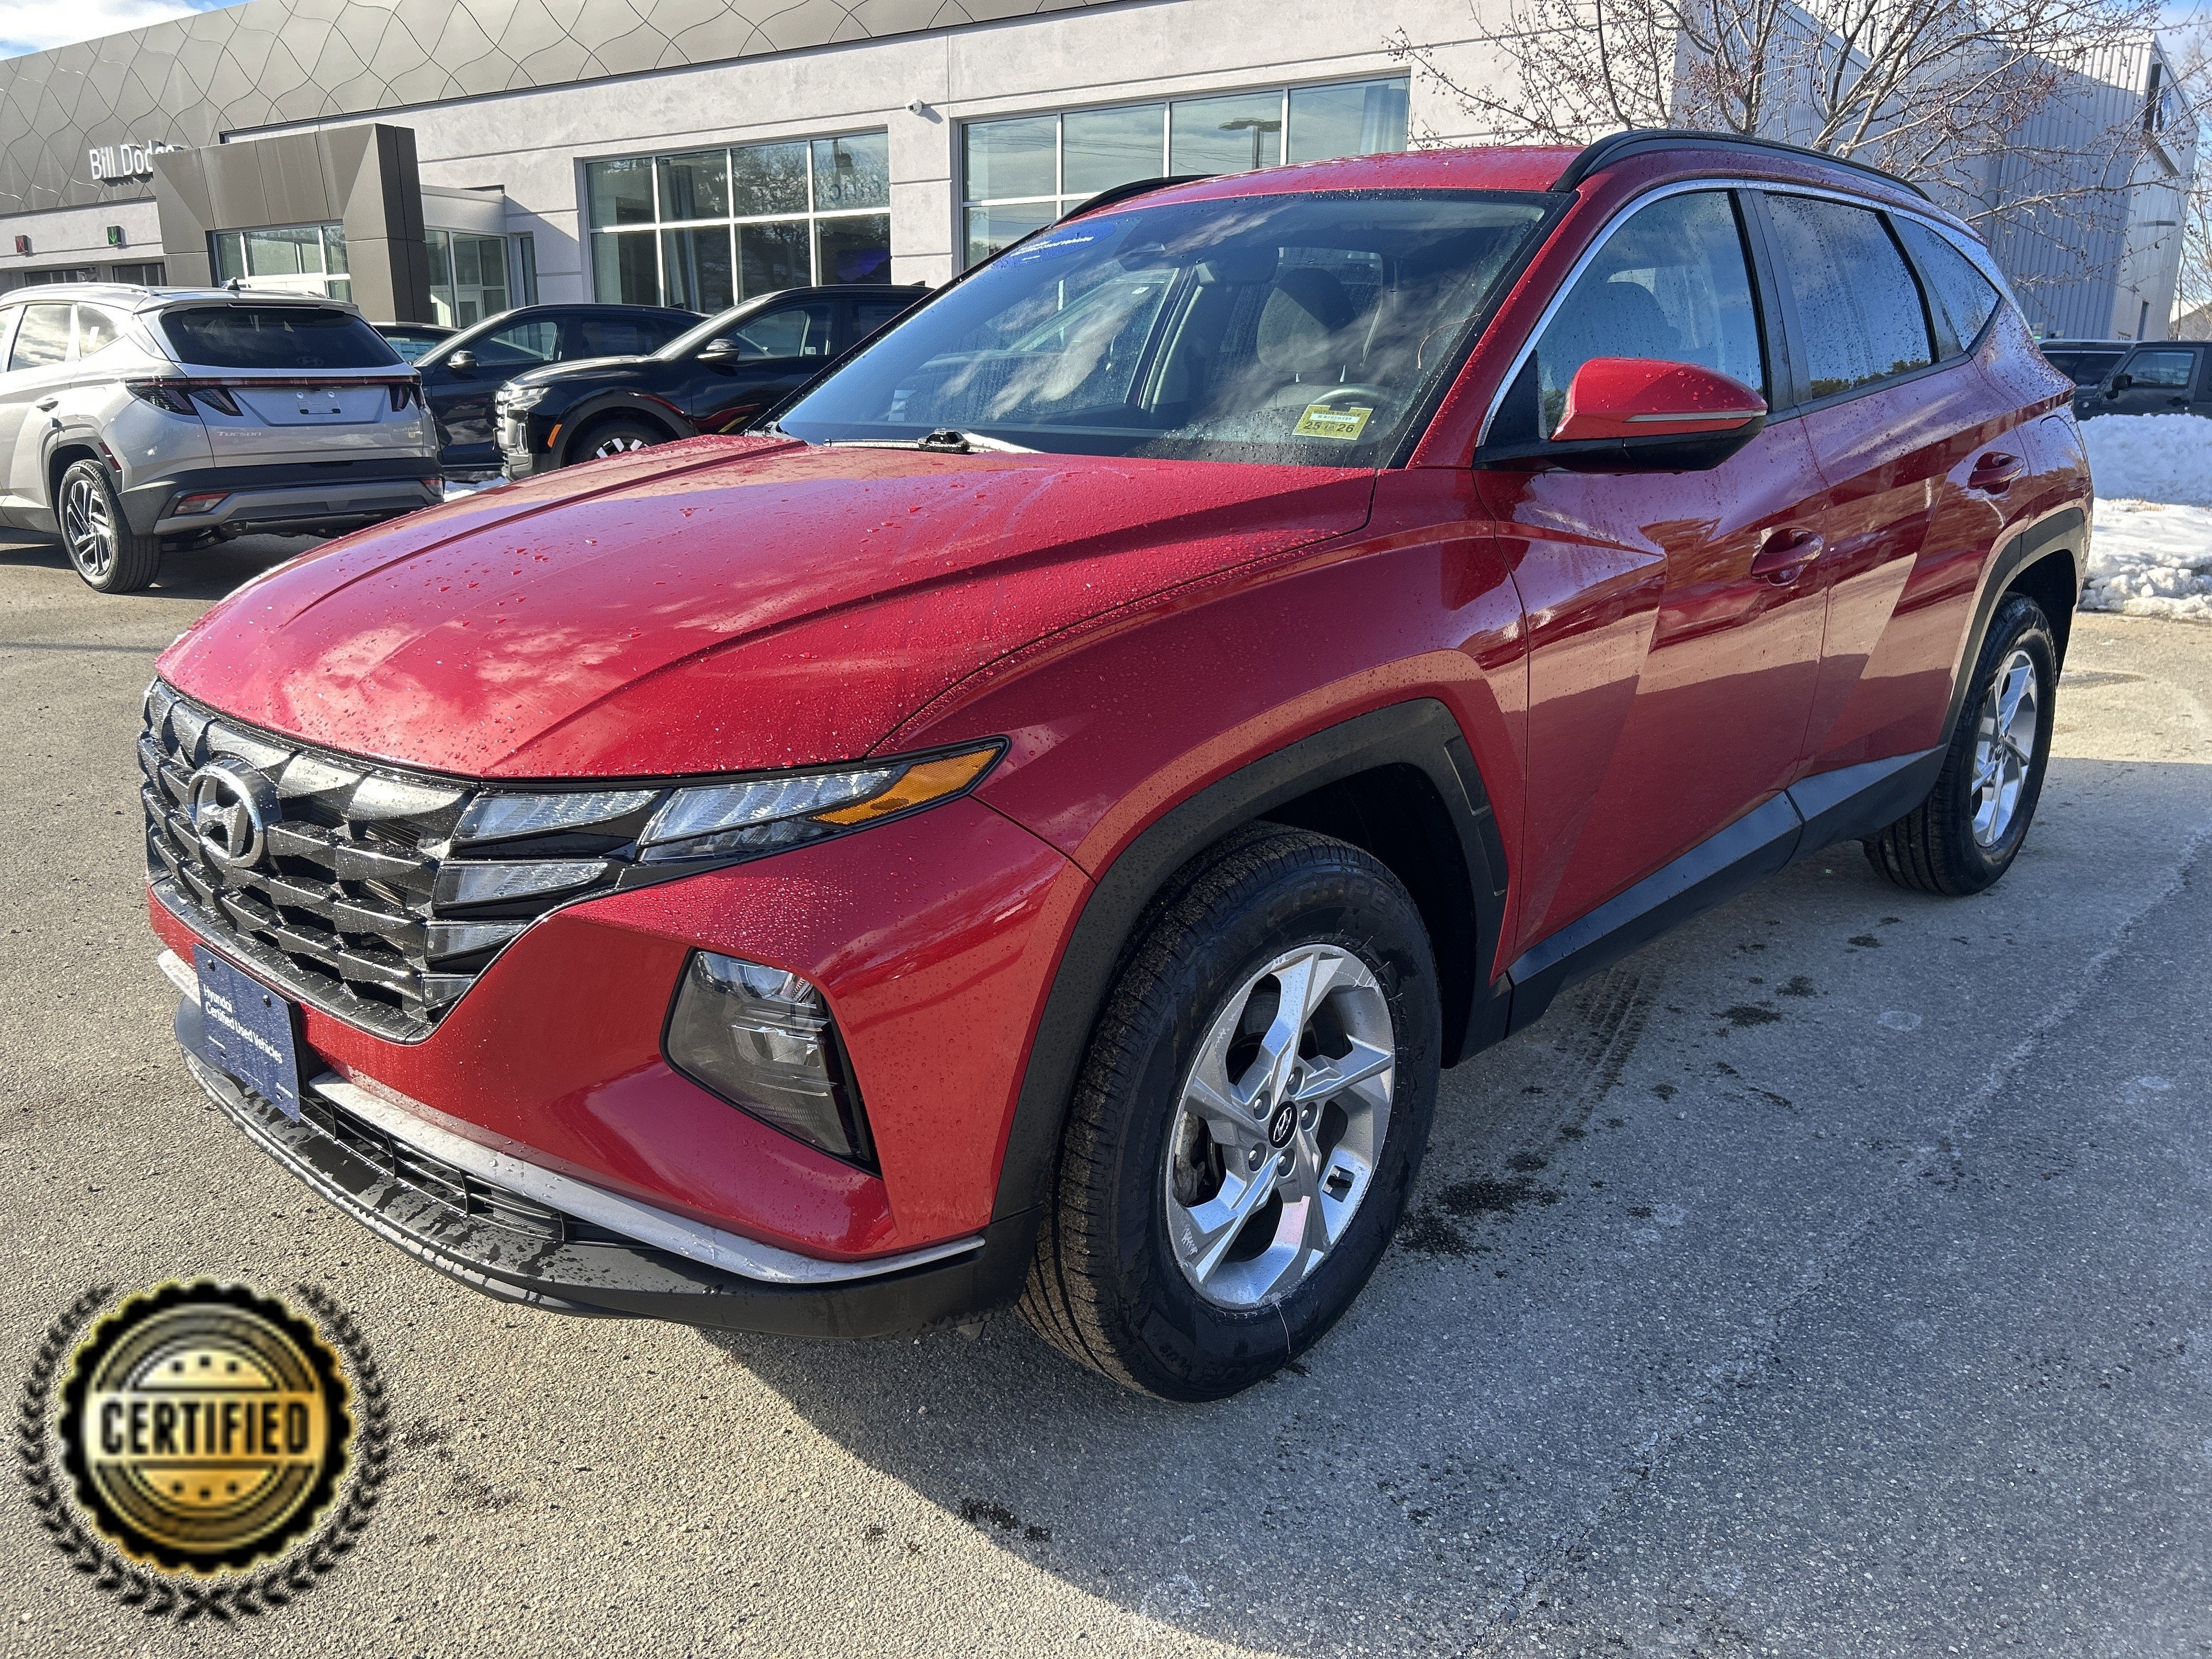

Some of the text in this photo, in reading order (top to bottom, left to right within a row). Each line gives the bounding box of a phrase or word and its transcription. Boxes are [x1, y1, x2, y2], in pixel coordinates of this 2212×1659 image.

[89, 139, 175, 180] Bill Dod
[1303, 421, 1322, 430] 25
[1335, 423, 1355, 433] 26
[203, 983, 233, 1014] Hyundai
[205, 1001, 235, 1031] Certified
[234, 1019, 254, 1043] Used
[252, 1031, 284, 1064] Vehicles
